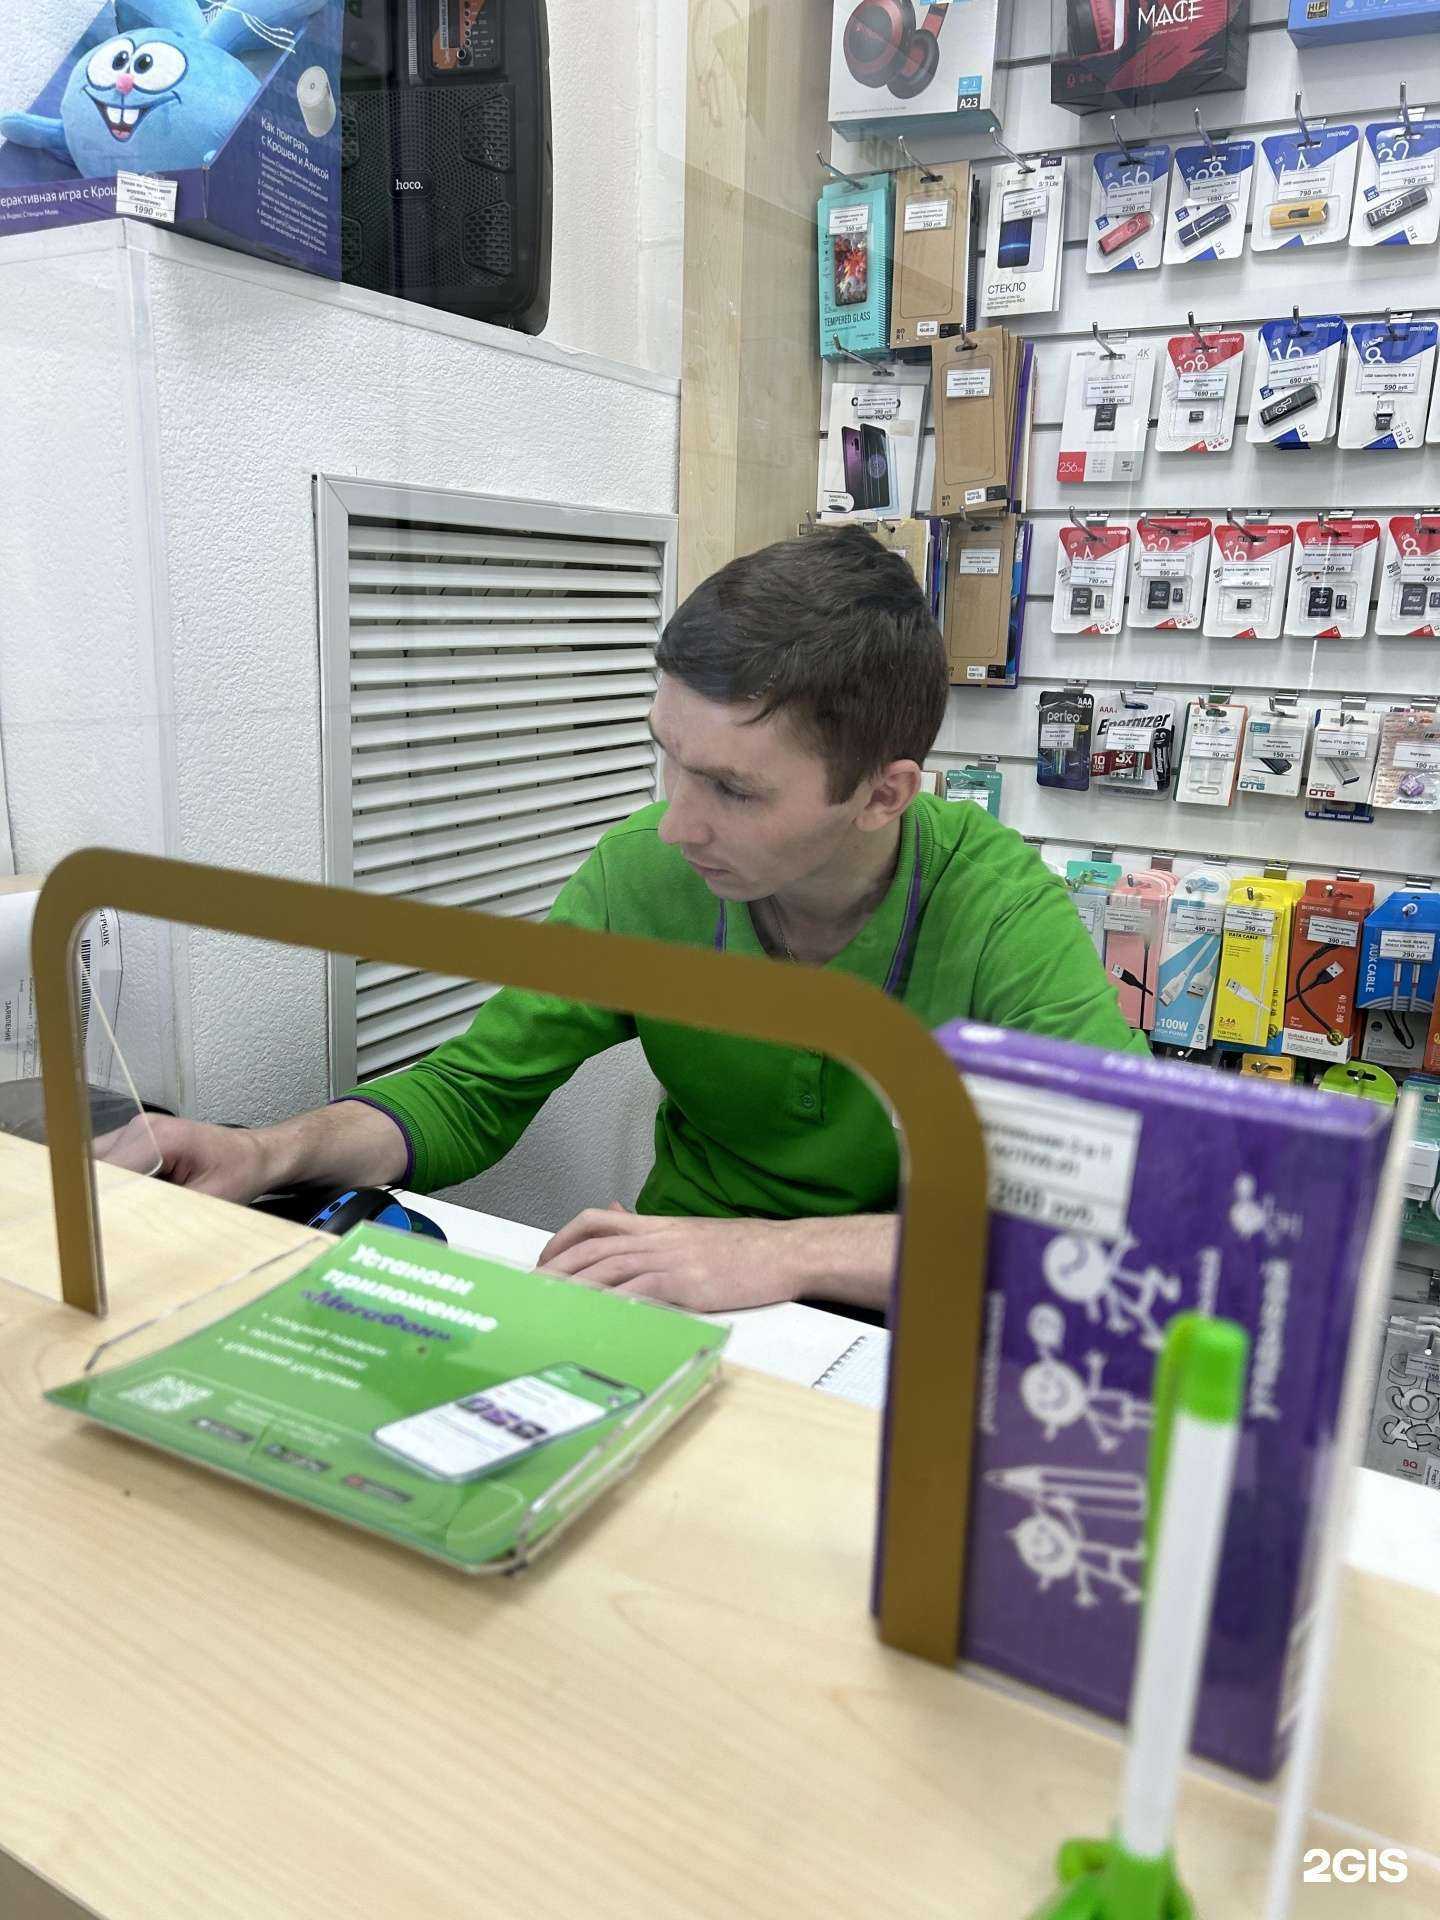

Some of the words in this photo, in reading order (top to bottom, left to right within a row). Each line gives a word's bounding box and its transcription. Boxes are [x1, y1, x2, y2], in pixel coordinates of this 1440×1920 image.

[959, 97, 978, 108] A23
[262, 117, 275, 134] Как
[276, 128, 309, 154] поиграть
[267, 139, 297, 161] Крошем
[305, 160, 329, 179] Алисой
[58, 190, 81, 203] игра
[135, 205, 153, 216] 1990
[988, 282, 1026, 294] СТЕКЛО
[824, 314, 851, 327] TEMPERED
[852, 312, 871, 323] GLASS
[1047, 710, 1080, 722] perfeo
[1093, 756, 1105, 764] 10
[1240, 781, 1265, 790] OTG
[1309, 789, 1335, 797] OTG
[1368, 944, 1379, 961] AUX
[1366, 962, 1377, 992] CABLE
[4, 1001, 12, 1041] ЗАЯВЛЕНИЕ
[1161, 1018, 1189, 1031] 100W
[350, 1244, 475, 1295] Установи
[322, 1269, 498, 1331] приложение
[1403, 1459, 1417, 1469] BQ
